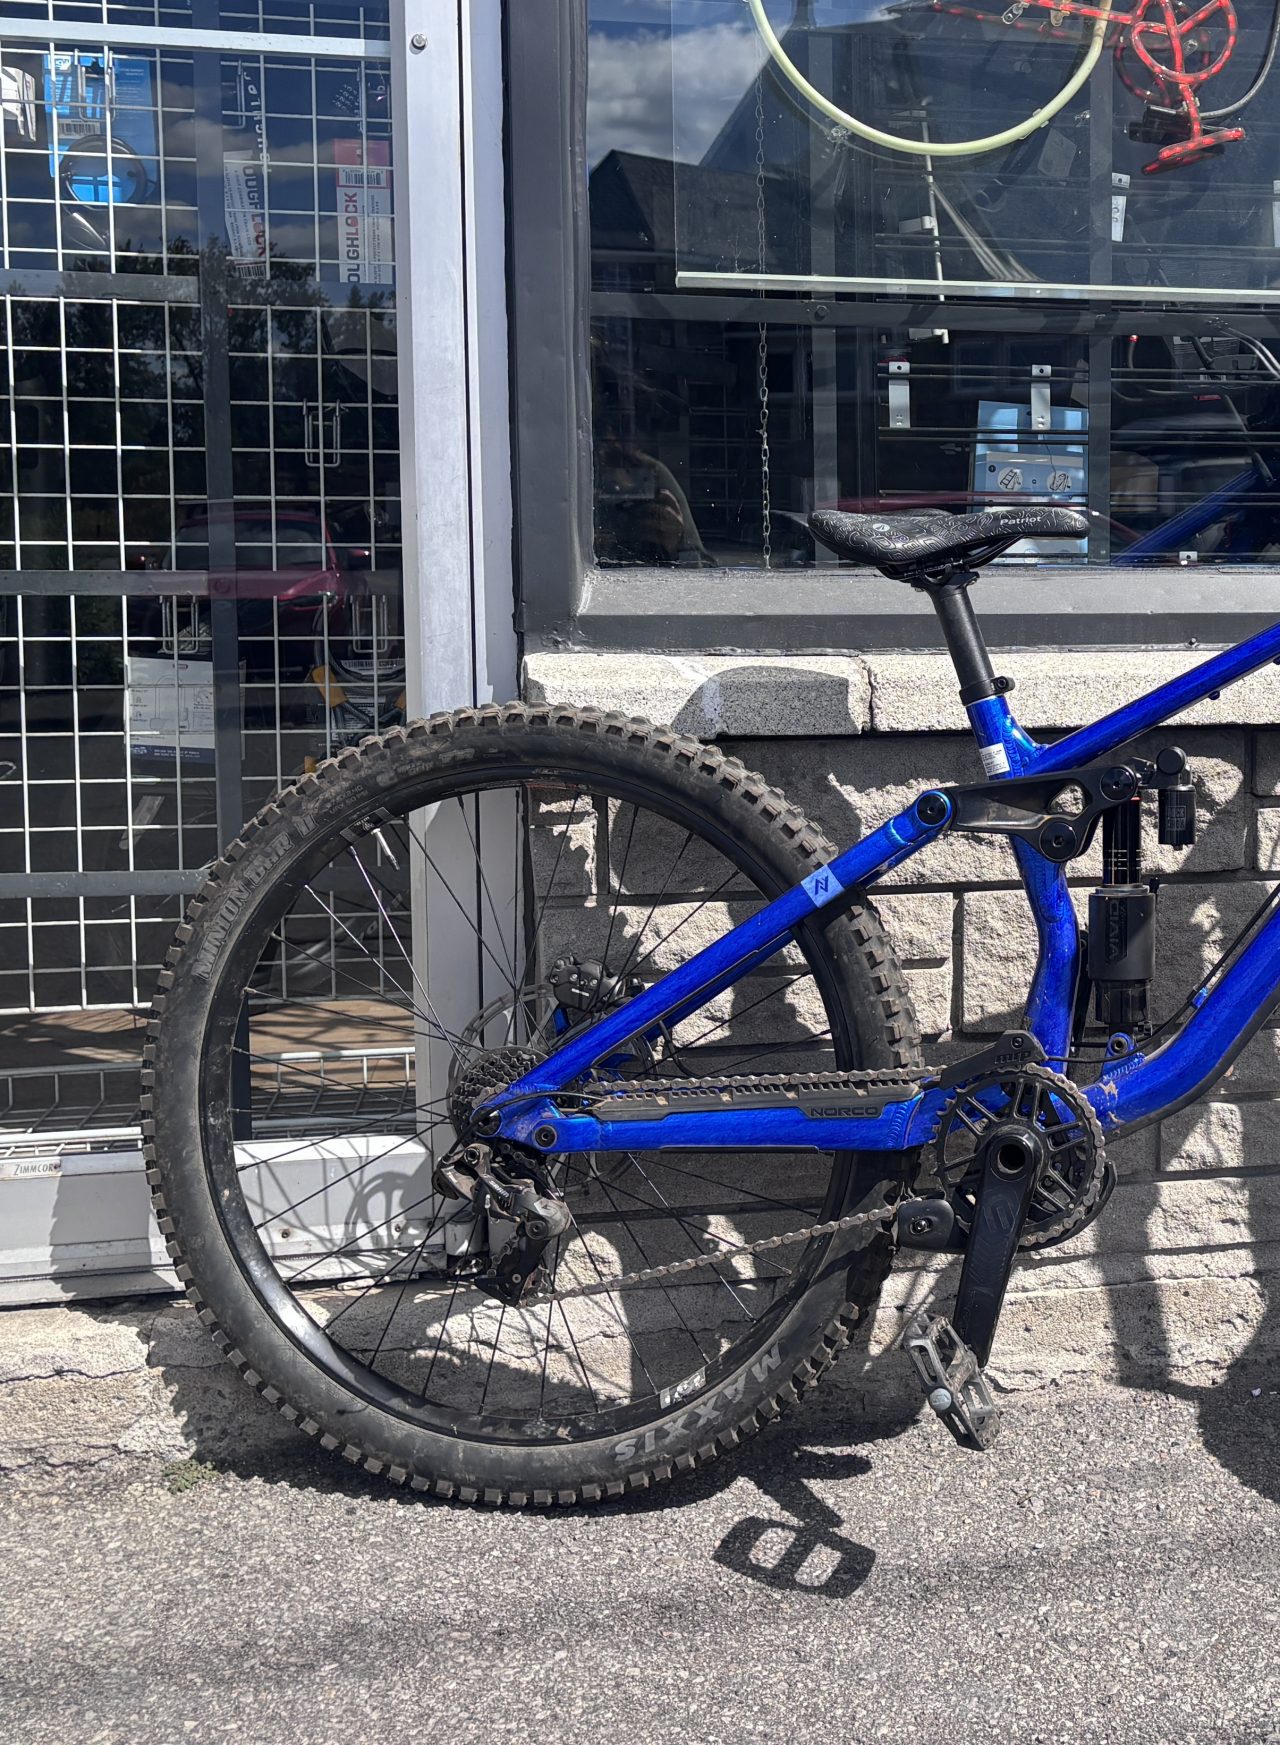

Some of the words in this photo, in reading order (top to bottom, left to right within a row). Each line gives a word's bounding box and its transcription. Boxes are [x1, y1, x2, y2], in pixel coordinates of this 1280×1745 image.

[343, 191, 361, 284] OUGHLOCK
[1000, 516, 1041, 526] Patriot
[192, 881, 251, 981] MINION
[810, 1106, 878, 1117] NORCO
[614, 1340, 782, 1462] MAXXIS
